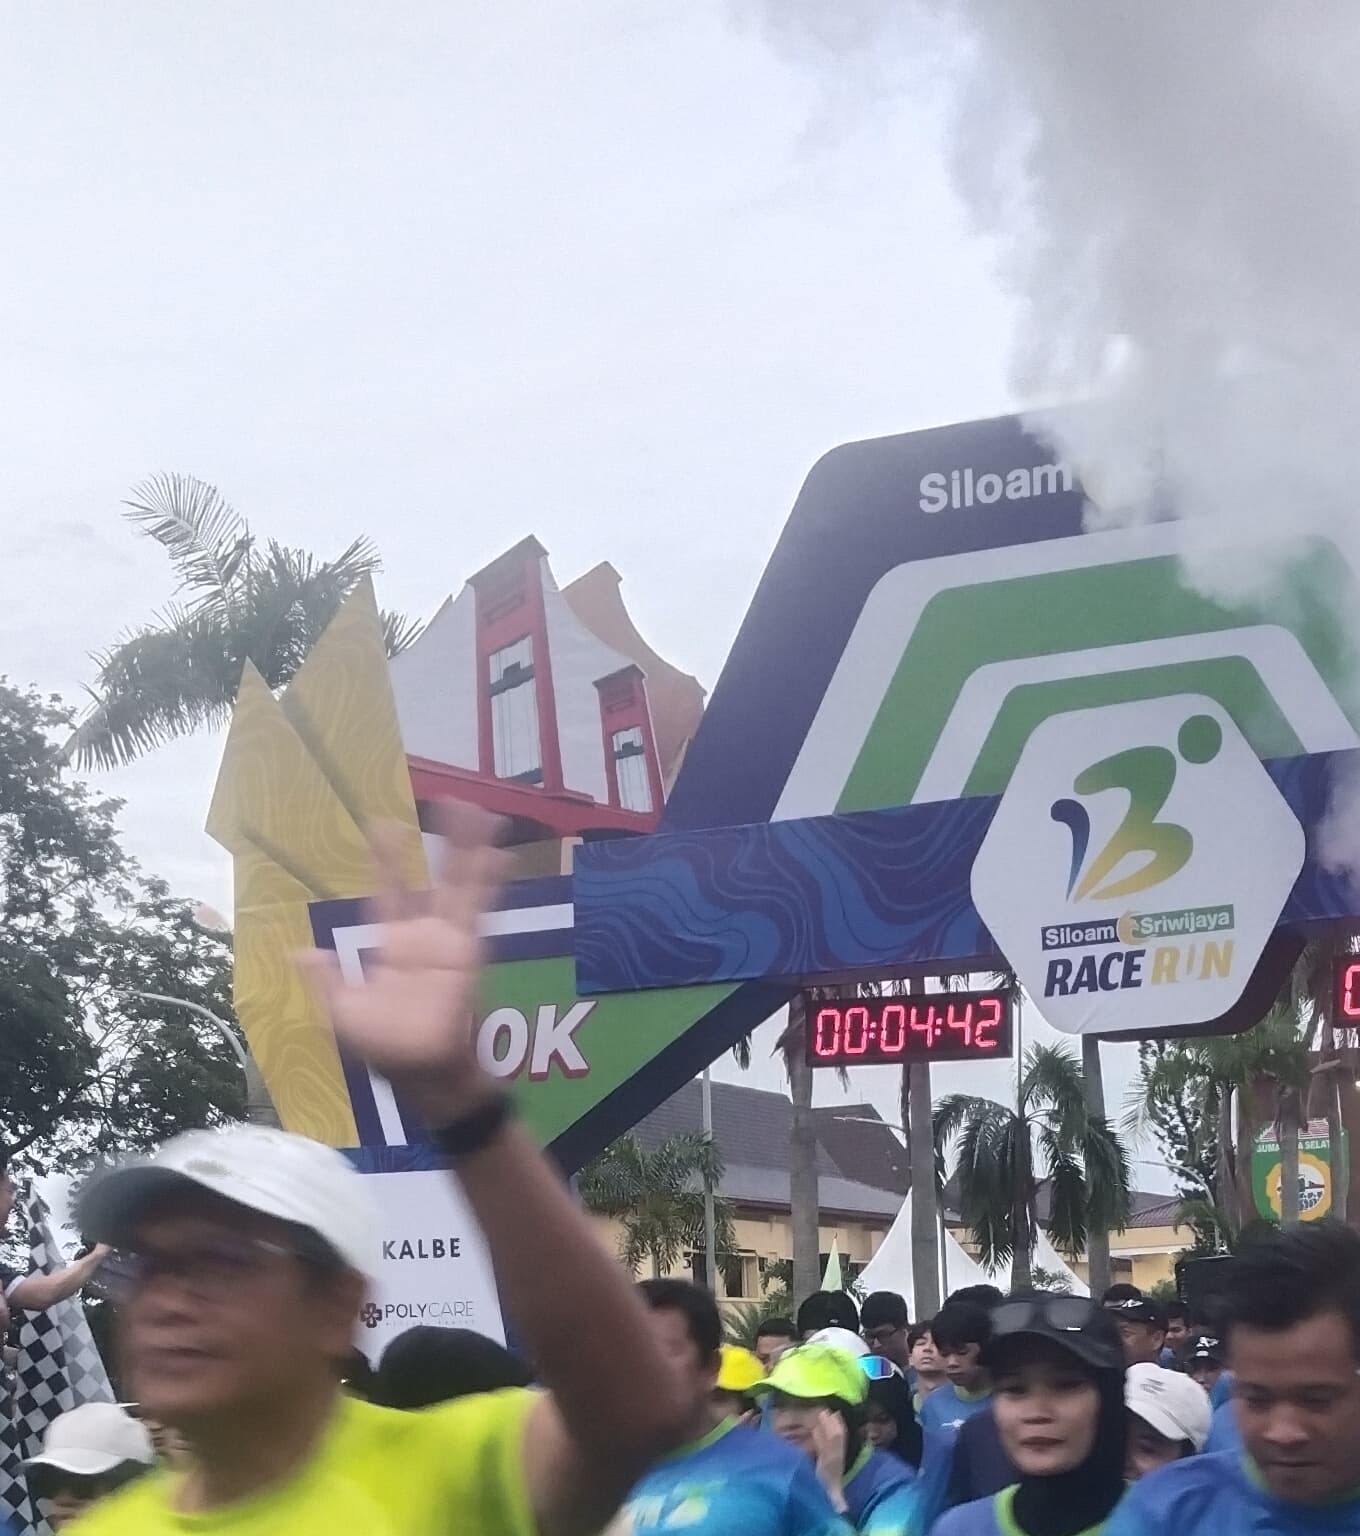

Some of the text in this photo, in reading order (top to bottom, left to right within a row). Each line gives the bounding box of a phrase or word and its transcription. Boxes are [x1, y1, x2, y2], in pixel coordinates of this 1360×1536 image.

[919, 461, 1073, 514] Siloam
[1045, 911, 1231, 946] Siloam Sriwijaya
[1043, 948, 1147, 998] RACE
[476, 1000, 598, 1082] 0K
[815, 999, 1001, 1056] 00:04:42
[382, 1237, 461, 1260] KALBE
[385, 1301, 474, 1319] POLYCARE
